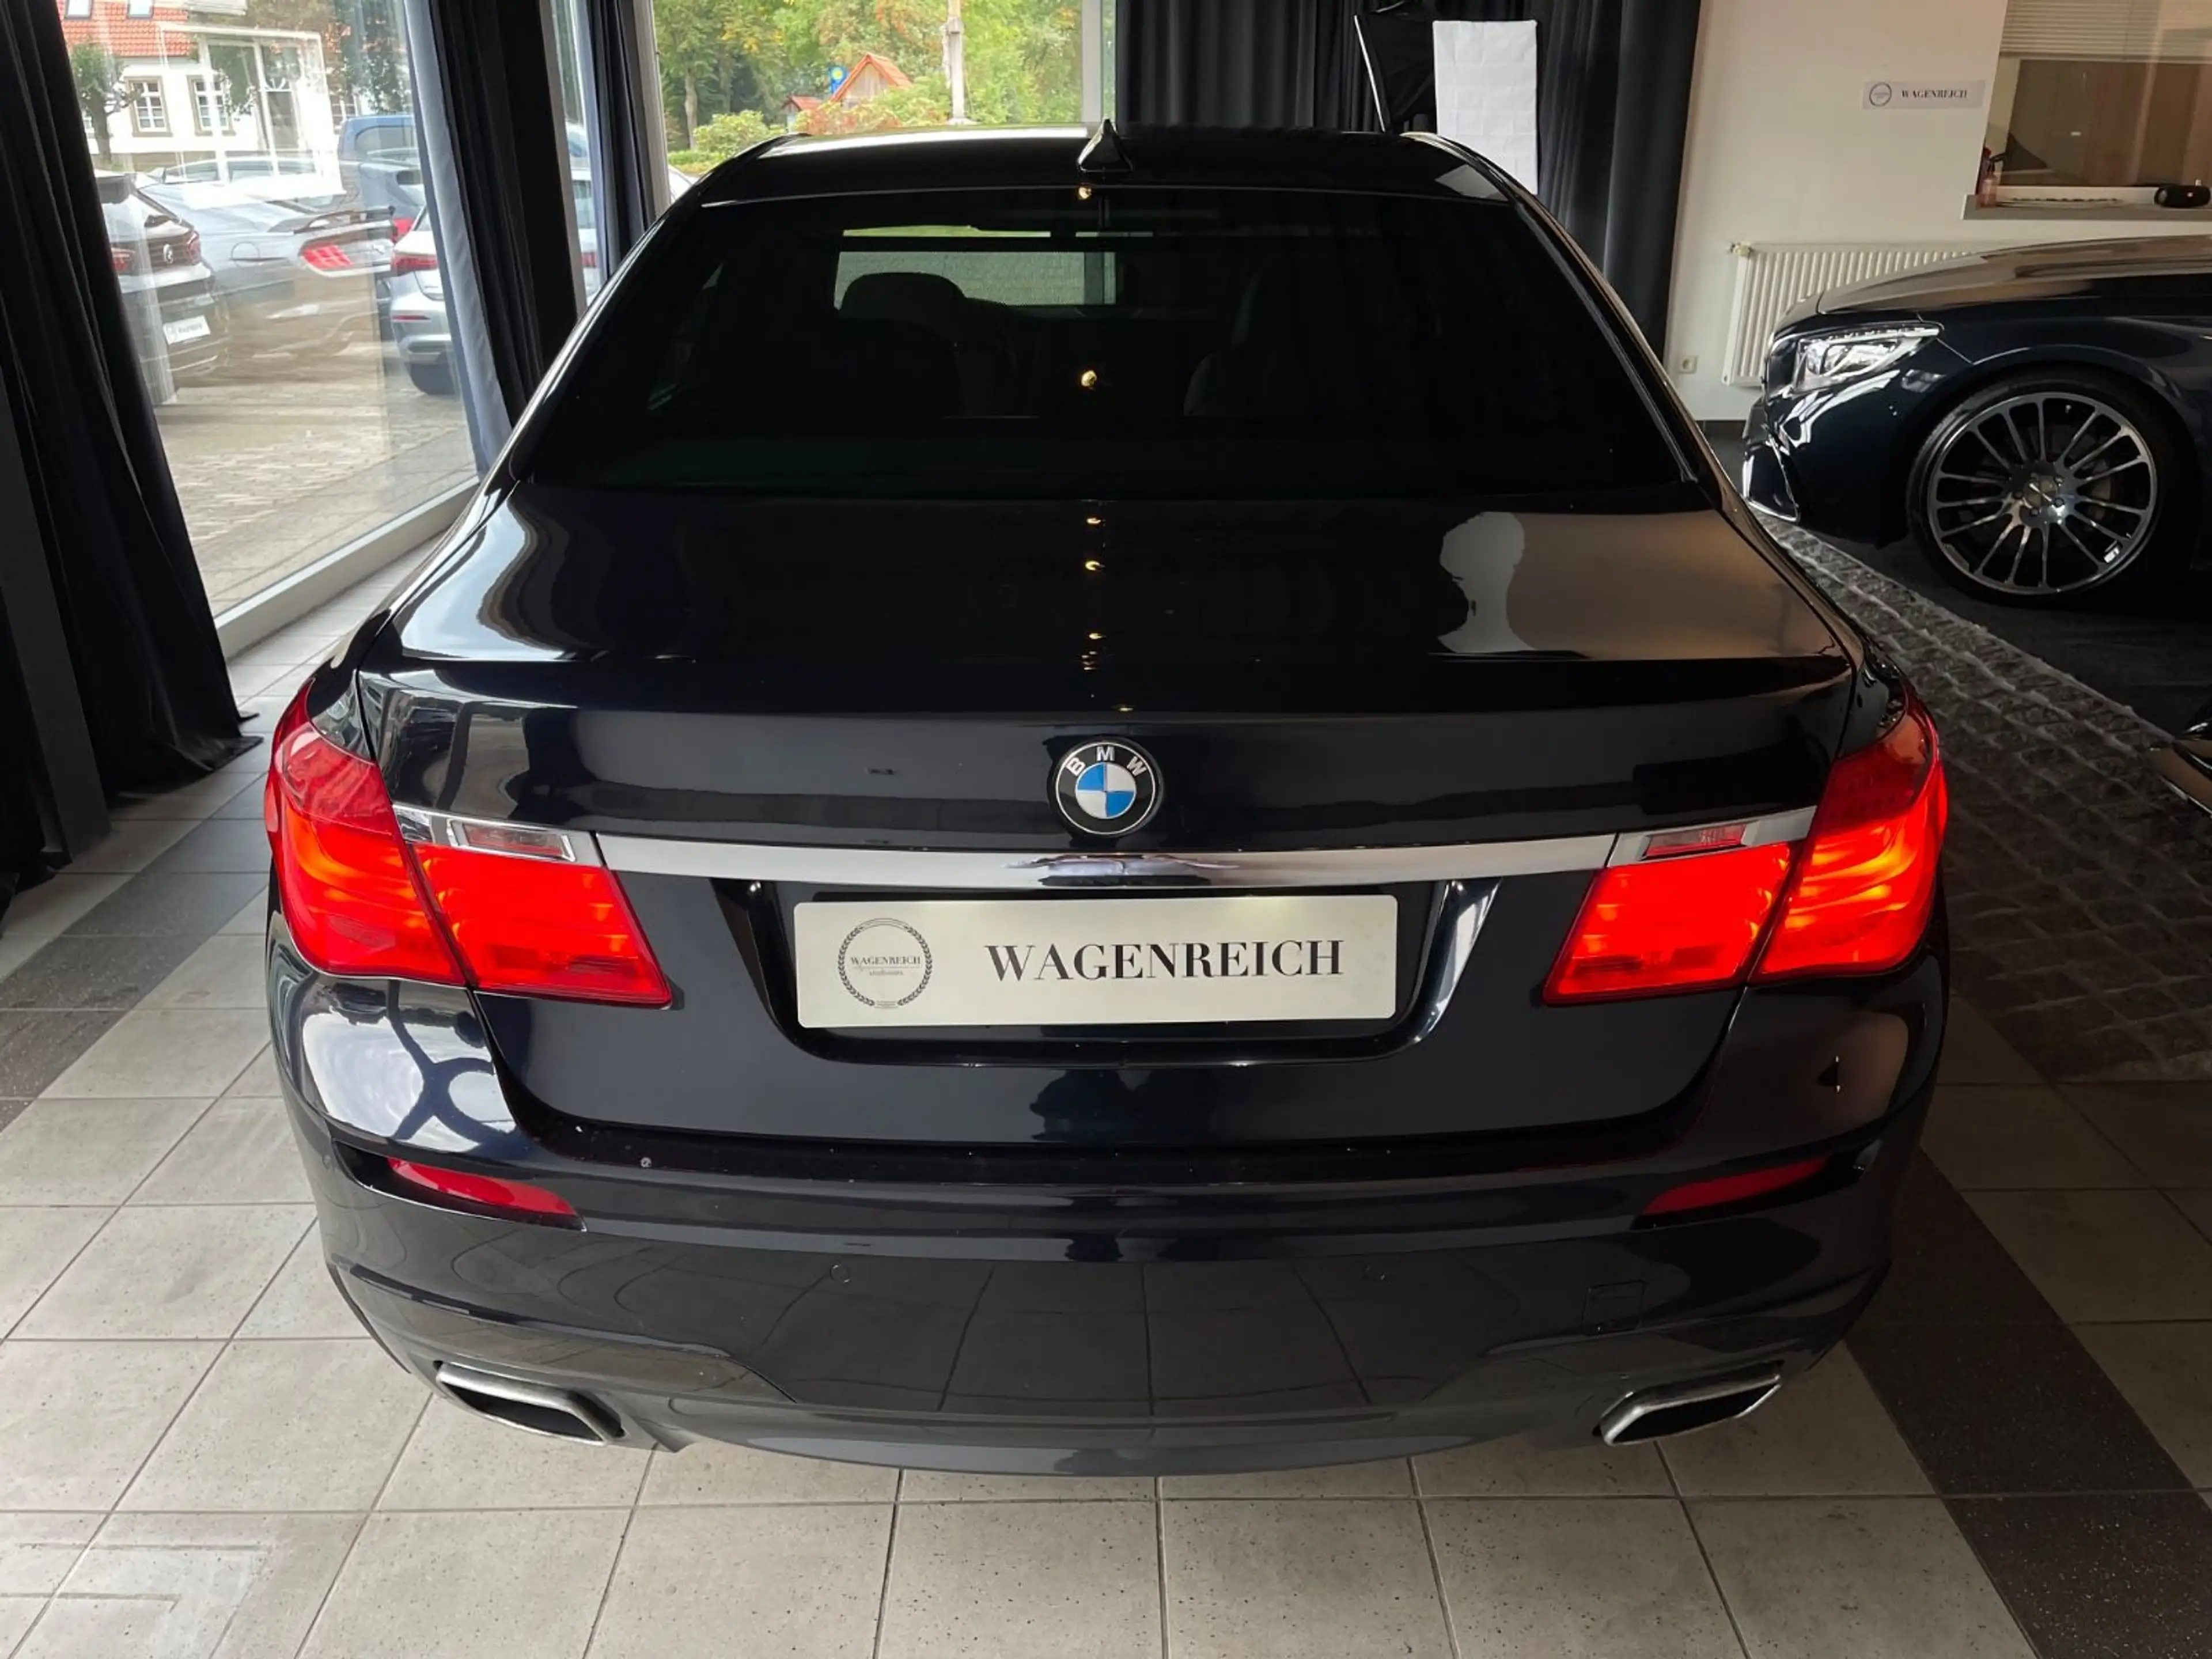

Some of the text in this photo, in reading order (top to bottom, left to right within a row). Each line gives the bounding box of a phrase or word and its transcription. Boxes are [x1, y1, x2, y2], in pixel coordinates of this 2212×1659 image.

[1066, 746, 1147, 777] BMW
[850, 956, 921, 965] WAGENREICH
[984, 940, 1345, 982] WAGENREICH
